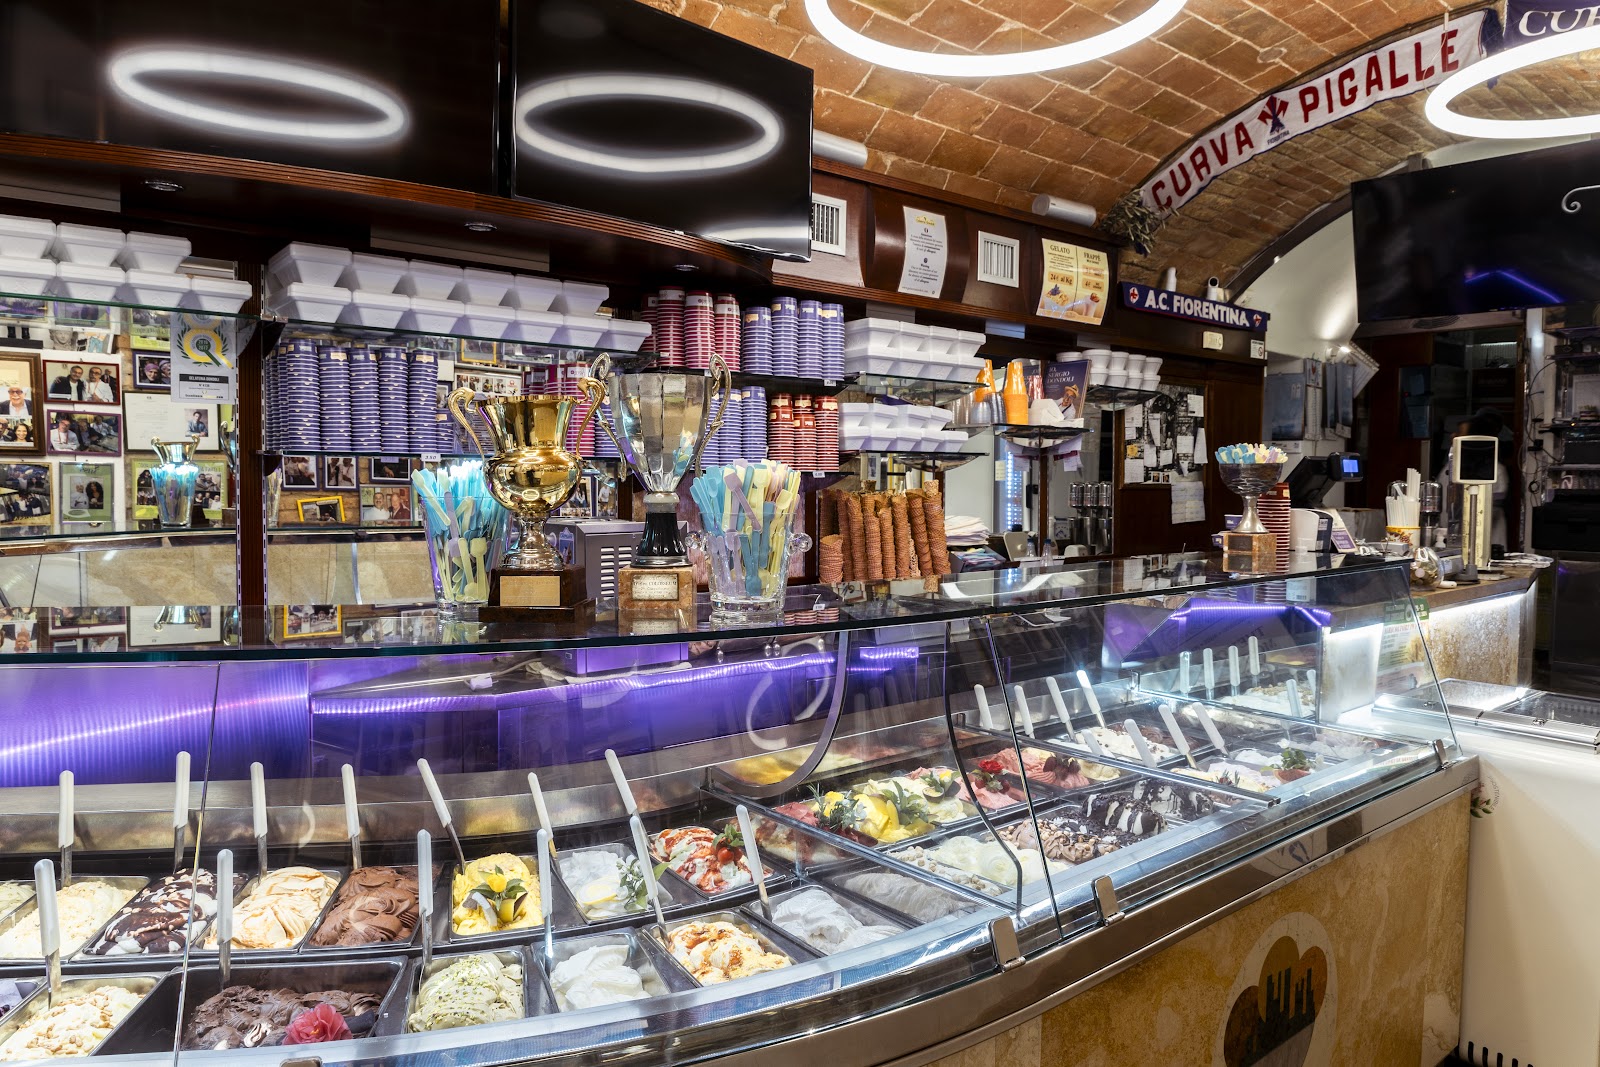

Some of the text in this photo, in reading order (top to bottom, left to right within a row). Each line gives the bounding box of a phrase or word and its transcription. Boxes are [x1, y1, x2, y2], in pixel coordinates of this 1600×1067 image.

[1151, 28, 1460, 212] CURVA PIGALLE
[1050, 245, 1070, 254] GELATO
[1144, 289, 1250, 327] A.C. FIORENTINA
[1047, 375, 1075, 384] DONDOLI
